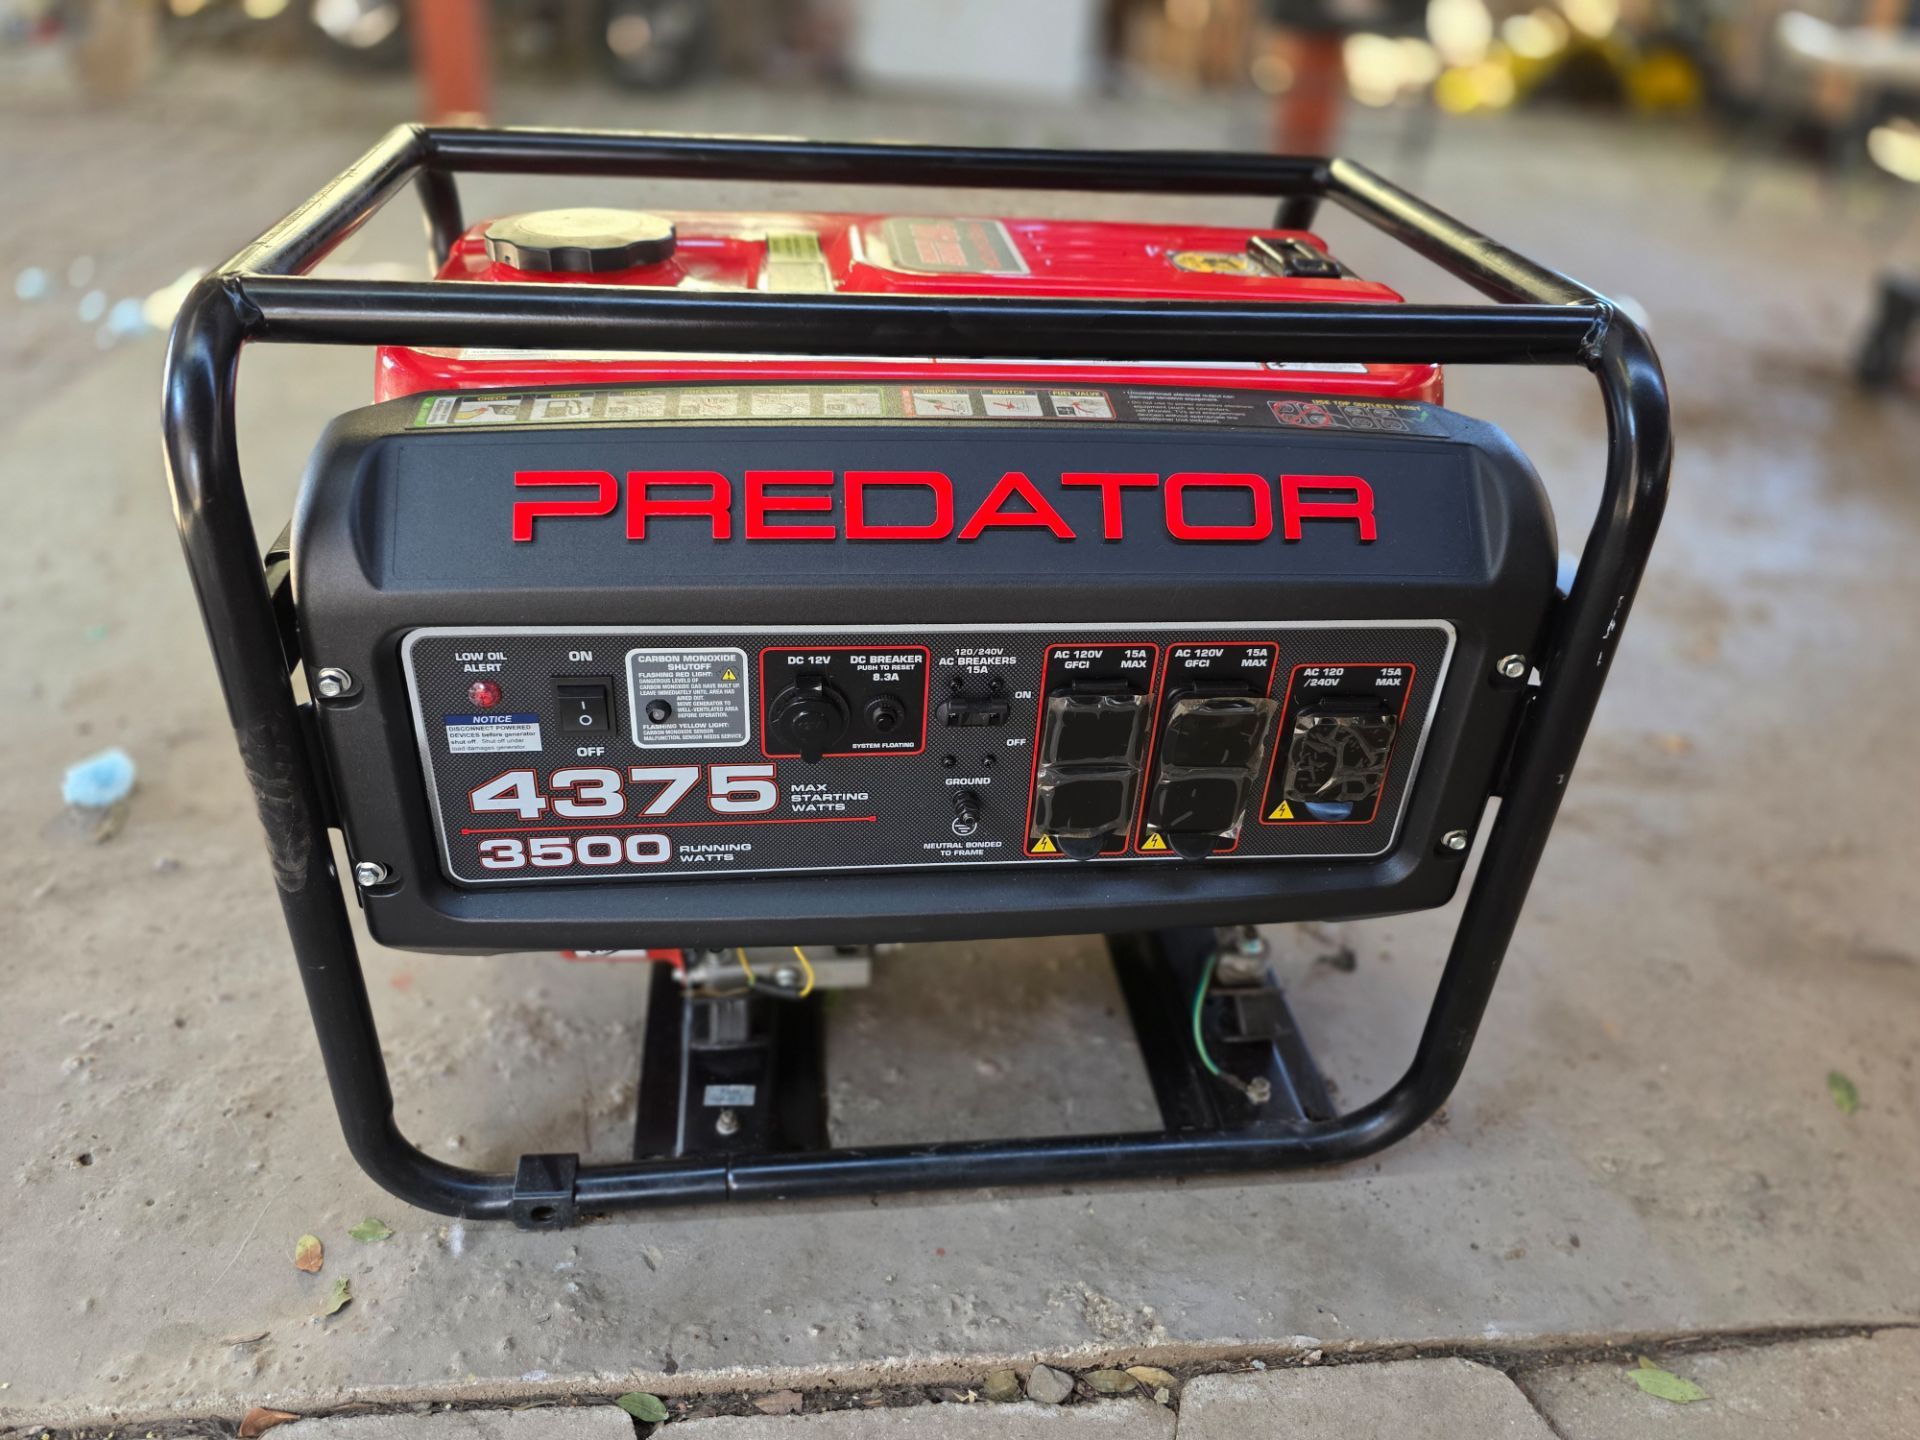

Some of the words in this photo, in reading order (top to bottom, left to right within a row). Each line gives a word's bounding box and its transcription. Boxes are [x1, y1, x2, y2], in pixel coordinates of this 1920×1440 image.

[512, 470, 1377, 543] PREDATOR
[454, 652, 484, 661] LOW
[487, 652, 508, 660] OIL
[568, 650, 593, 662] ON
[955, 648, 1004, 656] 120/240V
[1054, 650, 1070, 659] AC
[1073, 650, 1103, 659] 120V
[1124, 649, 1146, 658] 15A
[1175, 649, 1192, 657] AC
[1194, 648, 1224, 657] 120V
[1245, 648, 1268, 657] 15A
[638, 655, 680, 663] CARBON
[682, 654, 736, 662] MONOXIDE
[788, 656, 804, 665] DC
[808, 656, 831, 664] 12V
[850, 656, 866, 664] DC
[869, 655, 923, 663] BREAKER
[958, 656, 1017, 665] BREAKERS
[1241, 658, 1268, 667] MAX
[464, 664, 502, 672] ALERT
[1064, 660, 1090, 669] GFCI
[1120, 660, 1147, 668] MAX
[1185, 659, 1210, 668] GFCI
[966, 666, 988, 674] 15A
[1304, 668, 1320, 676] AC
[1322, 668, 1344, 676] 120
[1380, 668, 1402, 676] 15A
[873, 673, 899, 681] 8.3A
[1304, 678, 1340, 687] /240V
[1375, 678, 1401, 686] MAX
[1014, 691, 1031, 699] ON
[473, 715, 512, 723] NOTICE
[576, 746, 605, 757] OFF
[945, 778, 991, 786] GROUND
[467, 762, 780, 820] 4375
[791, 784, 827, 792] MAX
[791, 793, 869, 802] STARTING
[792, 803, 845, 812] WATTS
[479, 832, 672, 869] 3500
[679, 844, 752, 853] RUNNING
[680, 854, 734, 862] WATTS
